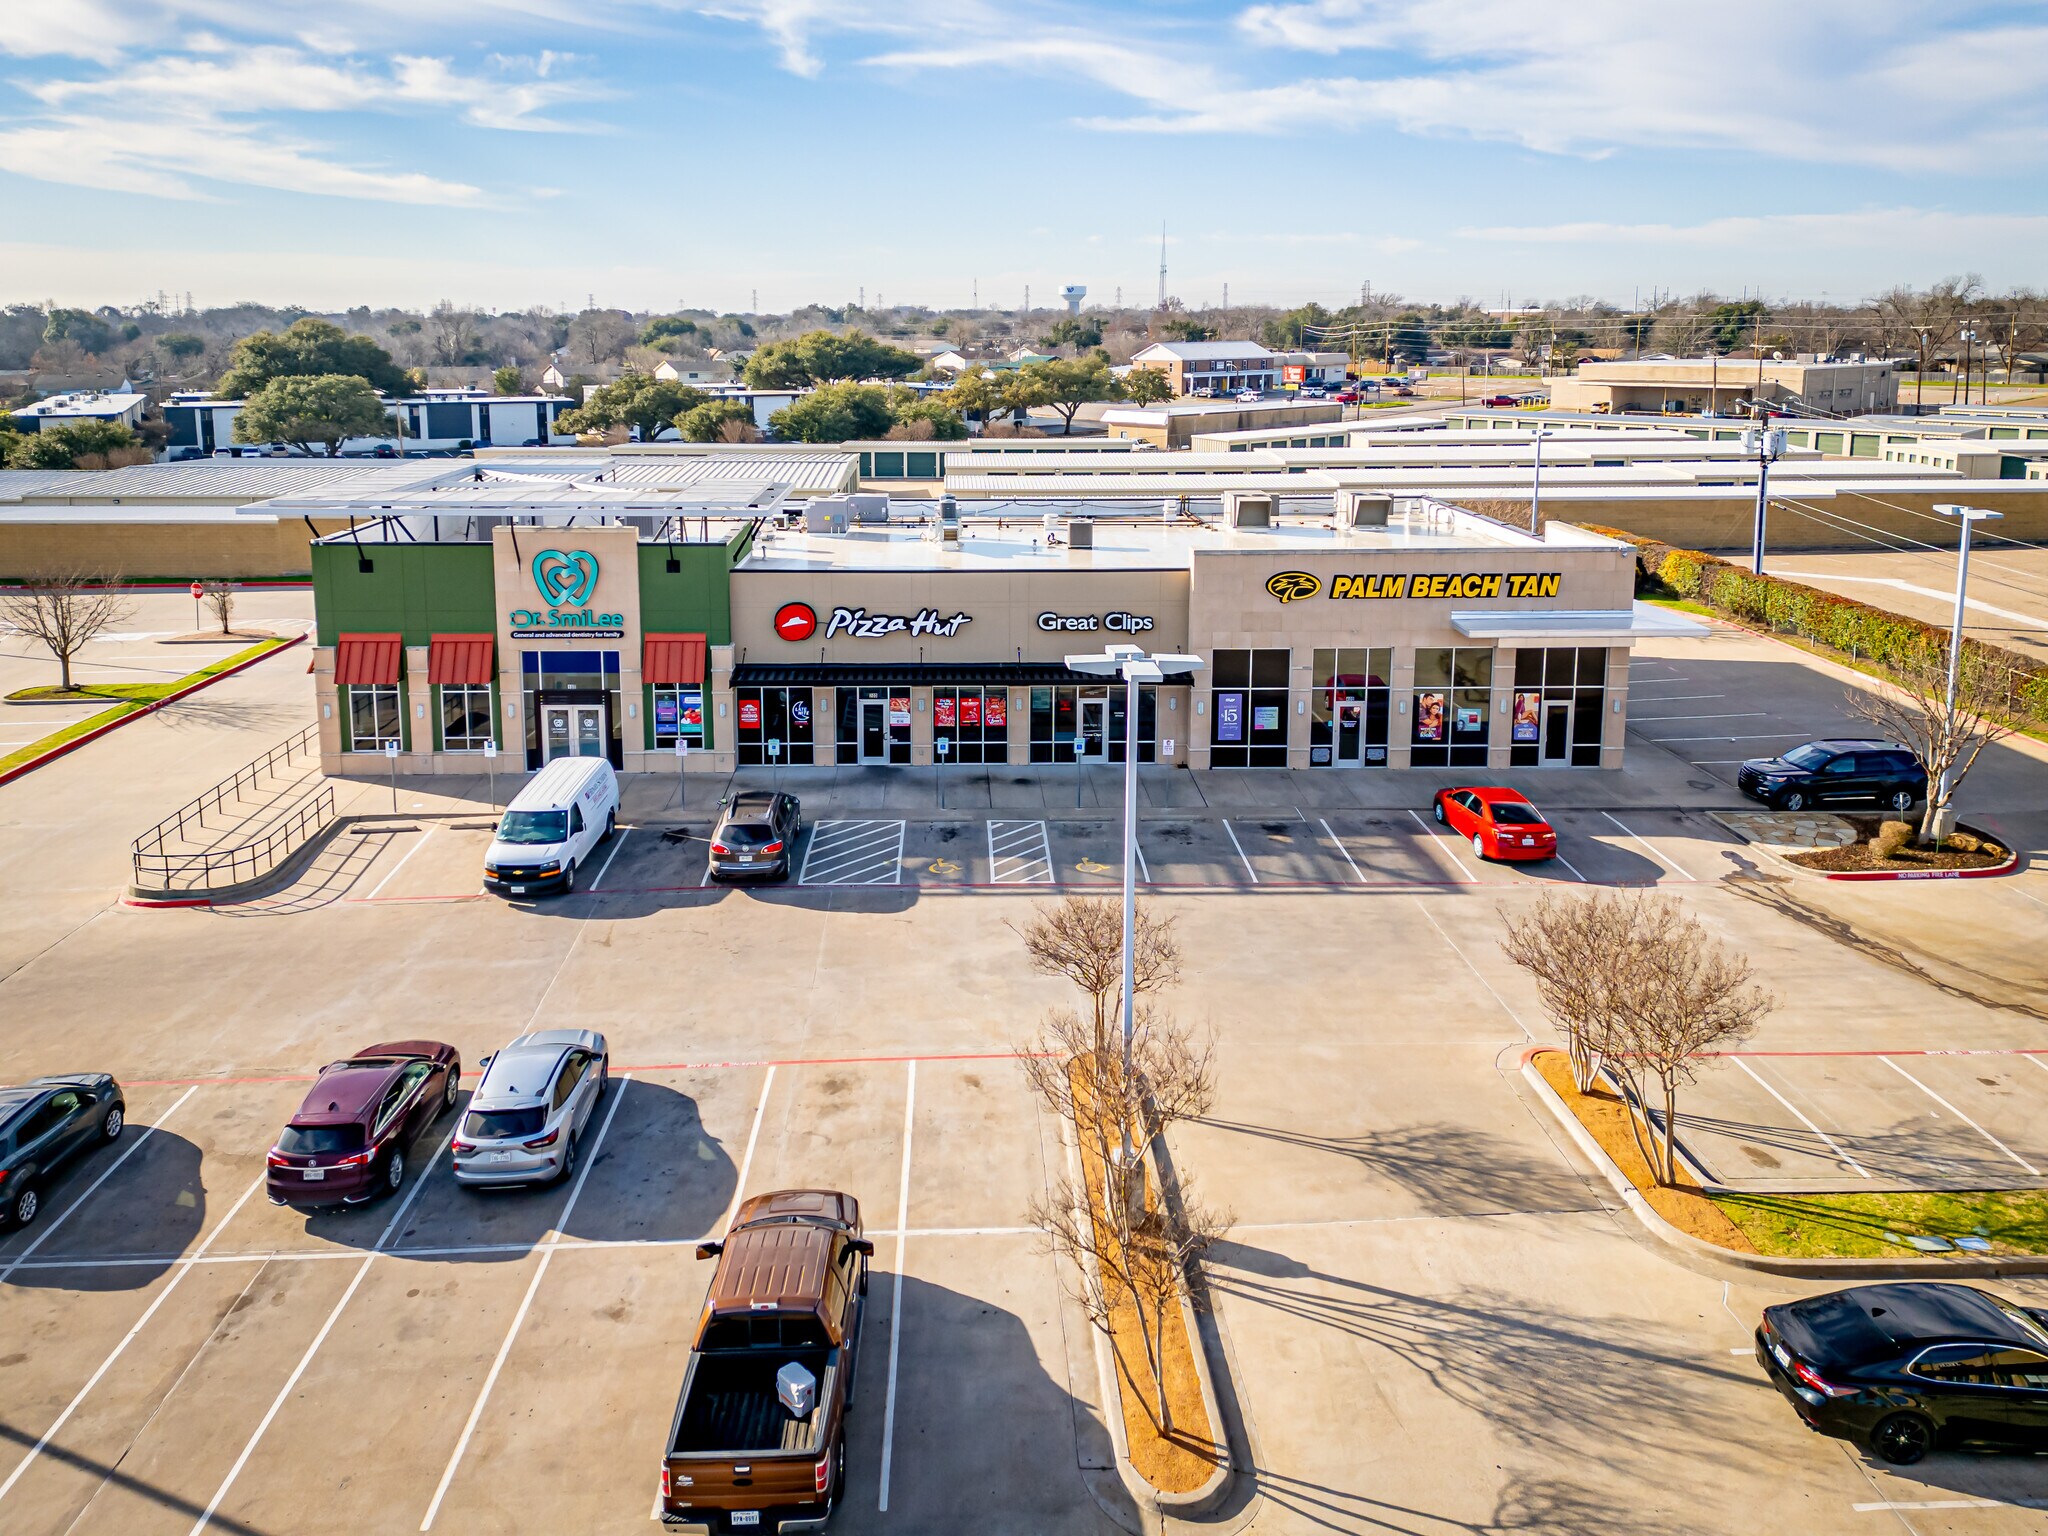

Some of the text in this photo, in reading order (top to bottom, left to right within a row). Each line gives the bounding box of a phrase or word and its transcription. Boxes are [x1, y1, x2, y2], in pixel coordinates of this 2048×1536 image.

[1332, 575, 1560, 598] PALM BEACH TAN
[509, 609, 624, 628] Dr. SmiLee
[826, 609, 972, 639] Pizza Hut
[1038, 612, 1153, 634] Great Clips
